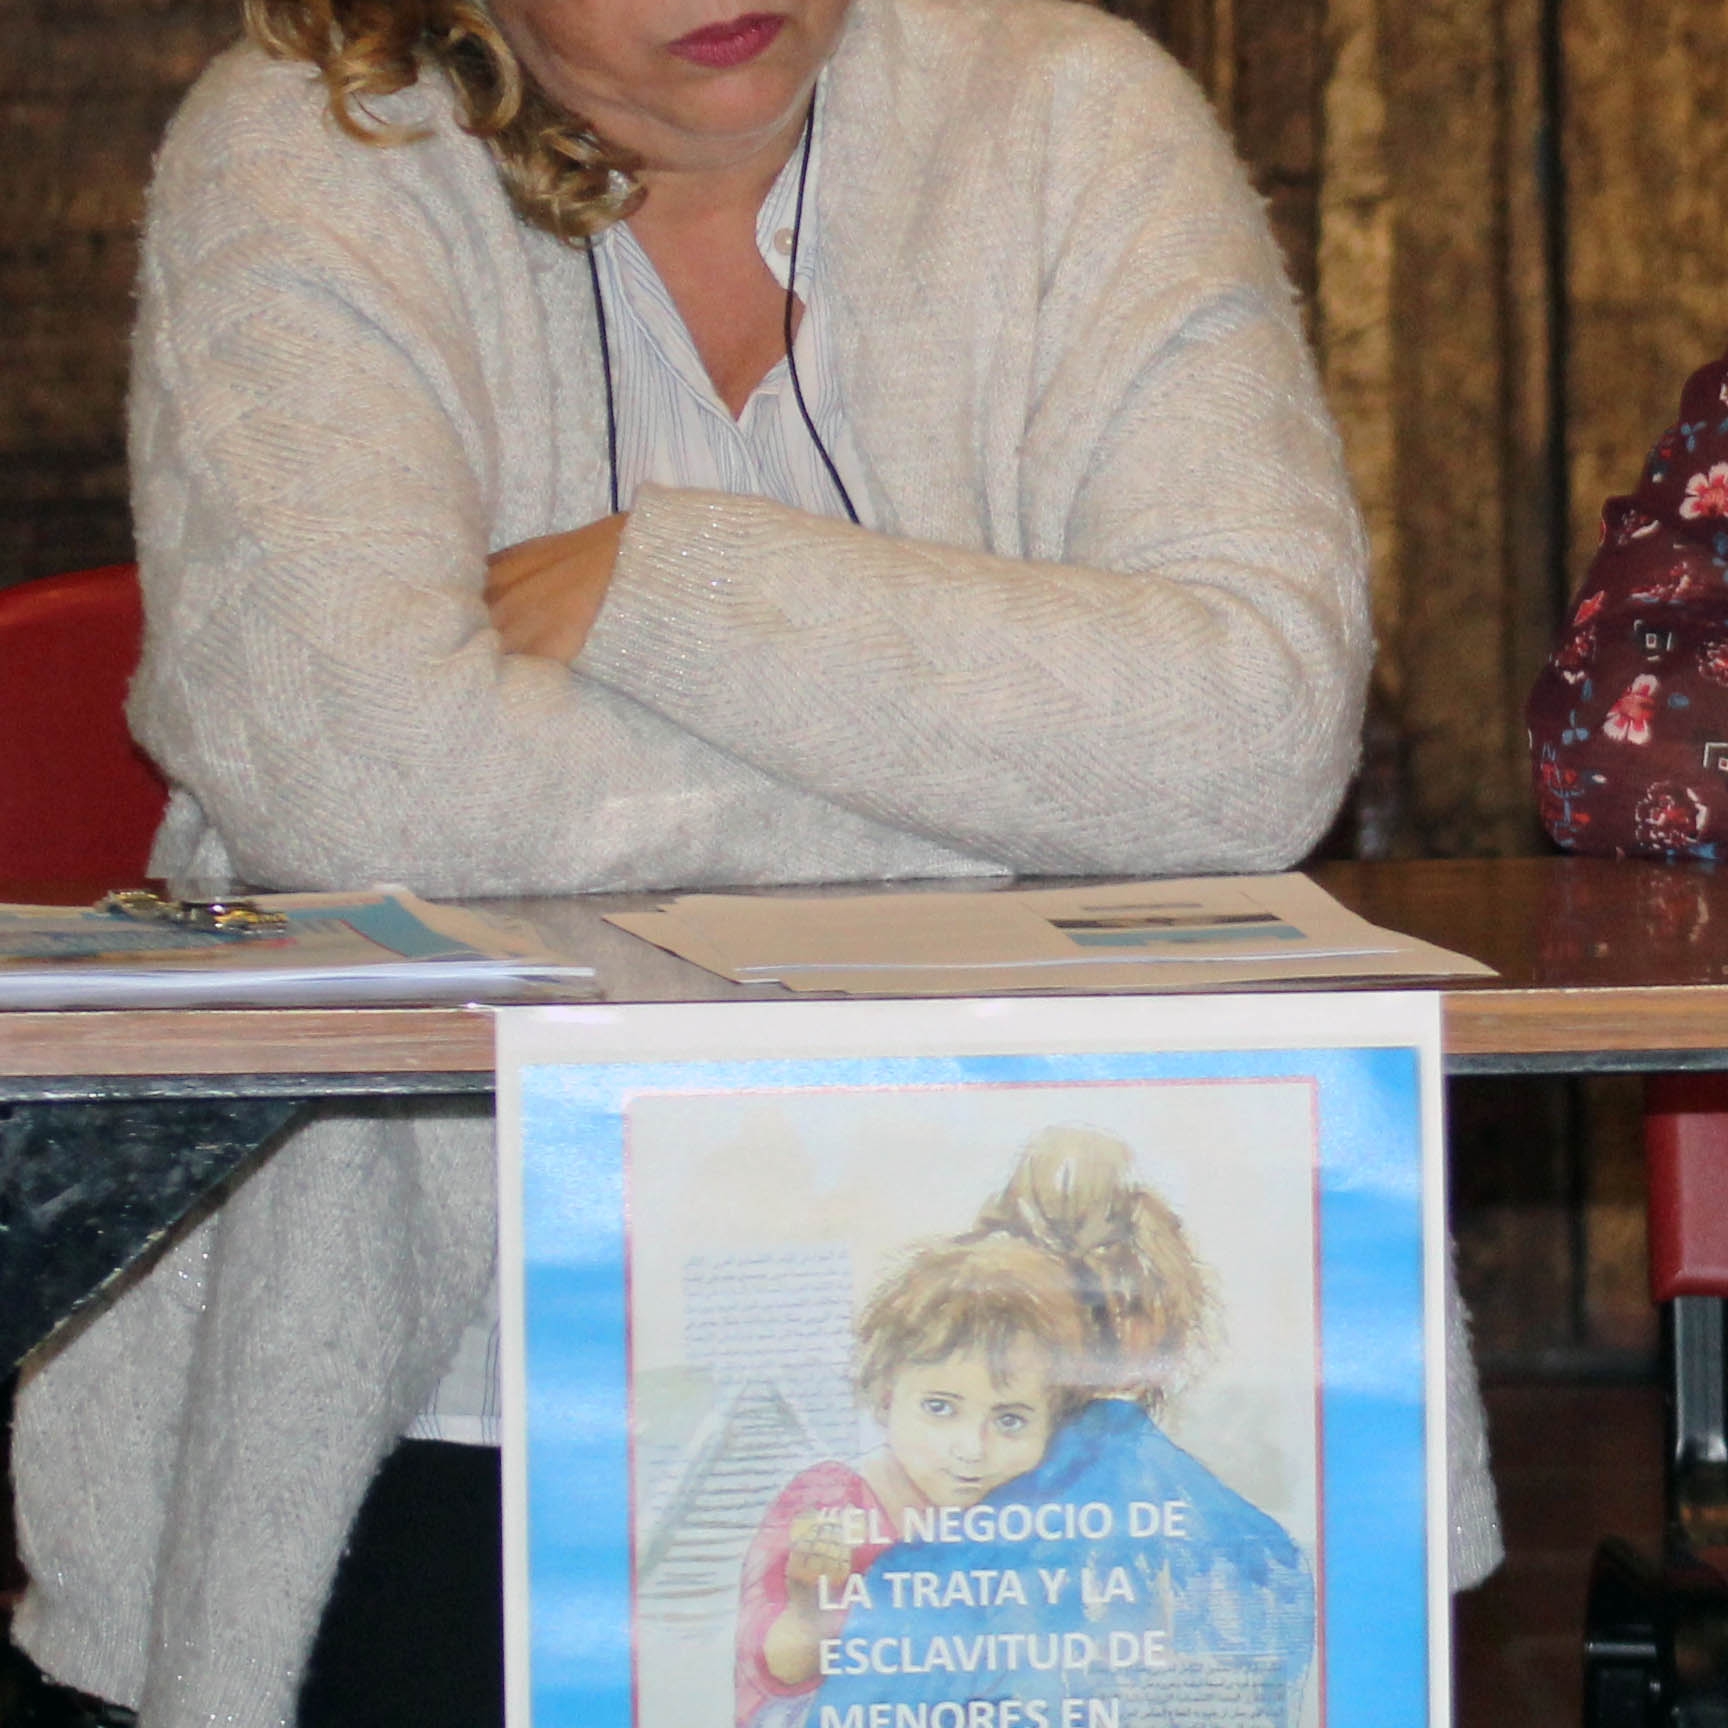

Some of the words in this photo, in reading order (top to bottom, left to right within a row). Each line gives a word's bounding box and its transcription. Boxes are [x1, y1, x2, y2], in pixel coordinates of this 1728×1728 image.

[904, 1503, 1114, 1544] NEGOCIO
[1129, 1501, 1189, 1540] DE
[818, 1574, 872, 1610] LA
[884, 1570, 1028, 1609] TRATA
[1038, 1568, 1066, 1605] Y
[1082, 1566, 1136, 1605] LA
[820, 1634, 1096, 1675] ESCLAVITUD
[1109, 1630, 1168, 1670] DE
[820, 1701, 1047, 1728] MENORES
[1062, 1699, 1120, 1728] EN
